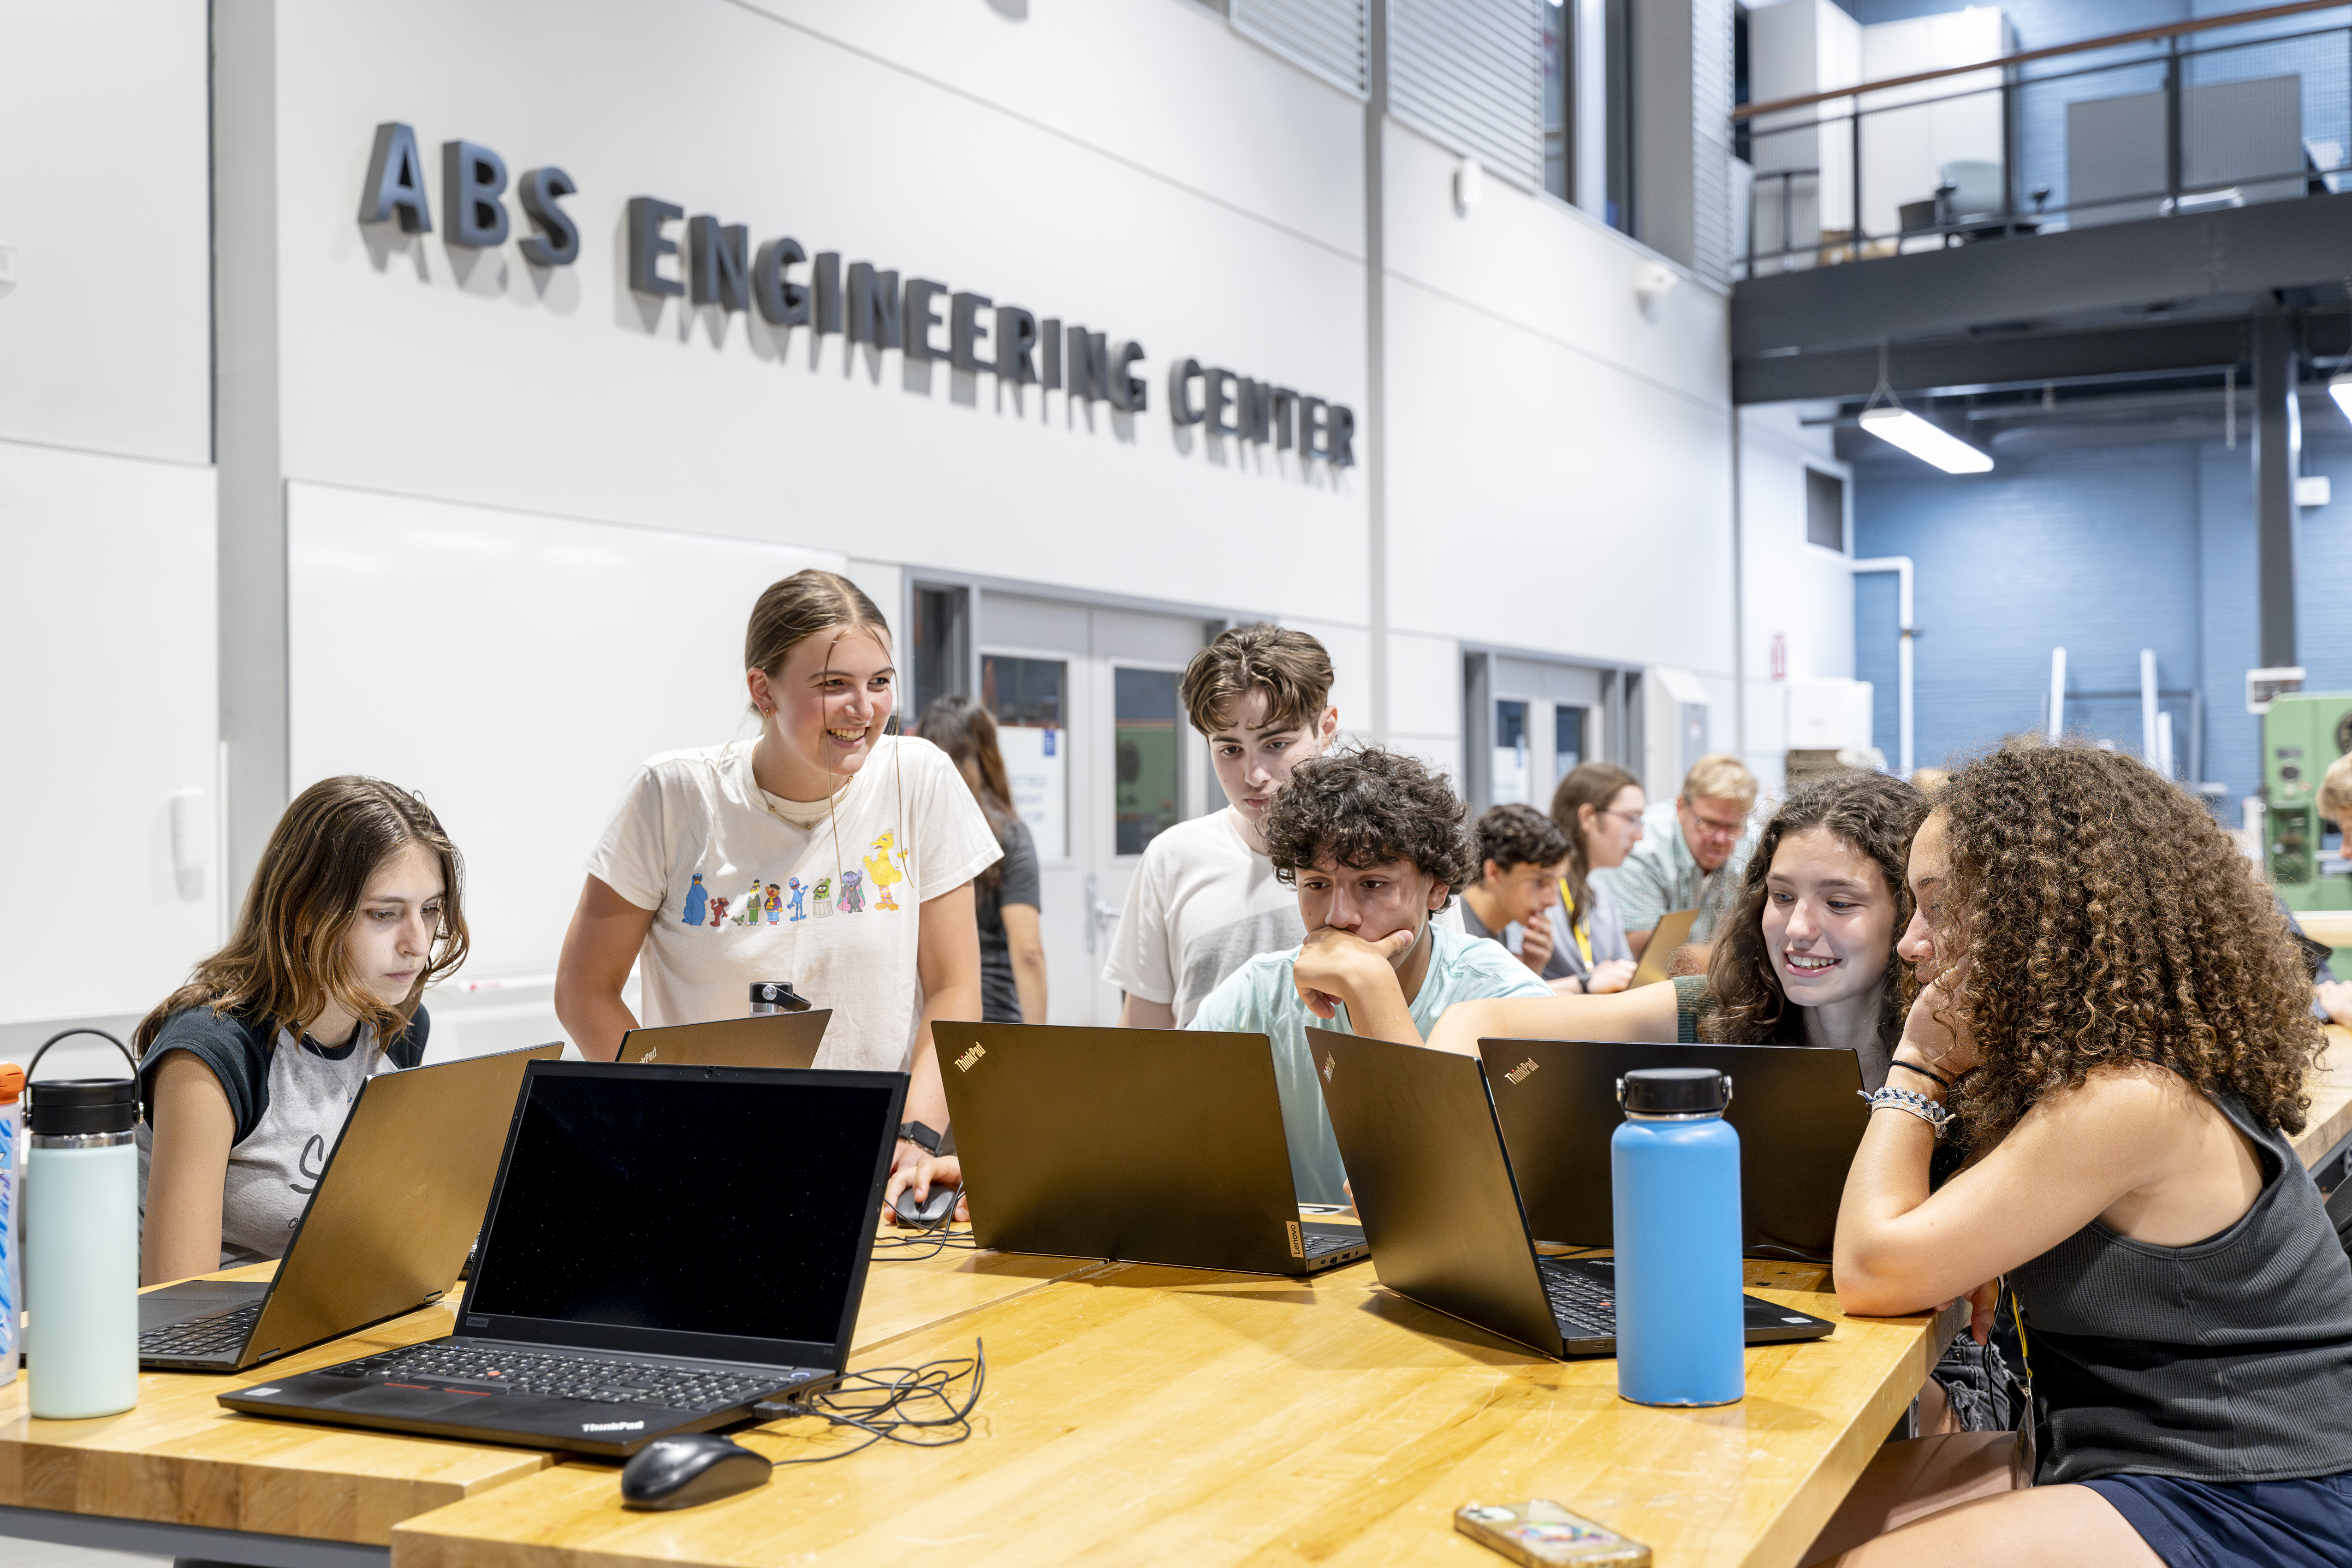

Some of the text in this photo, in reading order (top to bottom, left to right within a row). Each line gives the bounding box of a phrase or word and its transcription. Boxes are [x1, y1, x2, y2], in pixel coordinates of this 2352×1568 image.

[358, 122, 1355, 466] ABS ENGINEERING CENTER
[954, 1041, 986, 1073] ThinkPad
[1323, 1051, 1335, 1085] ThinkPad
[1504, 1057, 1539, 1085] ThinkPad
[1290, 1224, 1301, 1254] Lenovo
[581, 1420, 644, 1432] ThinkPad
